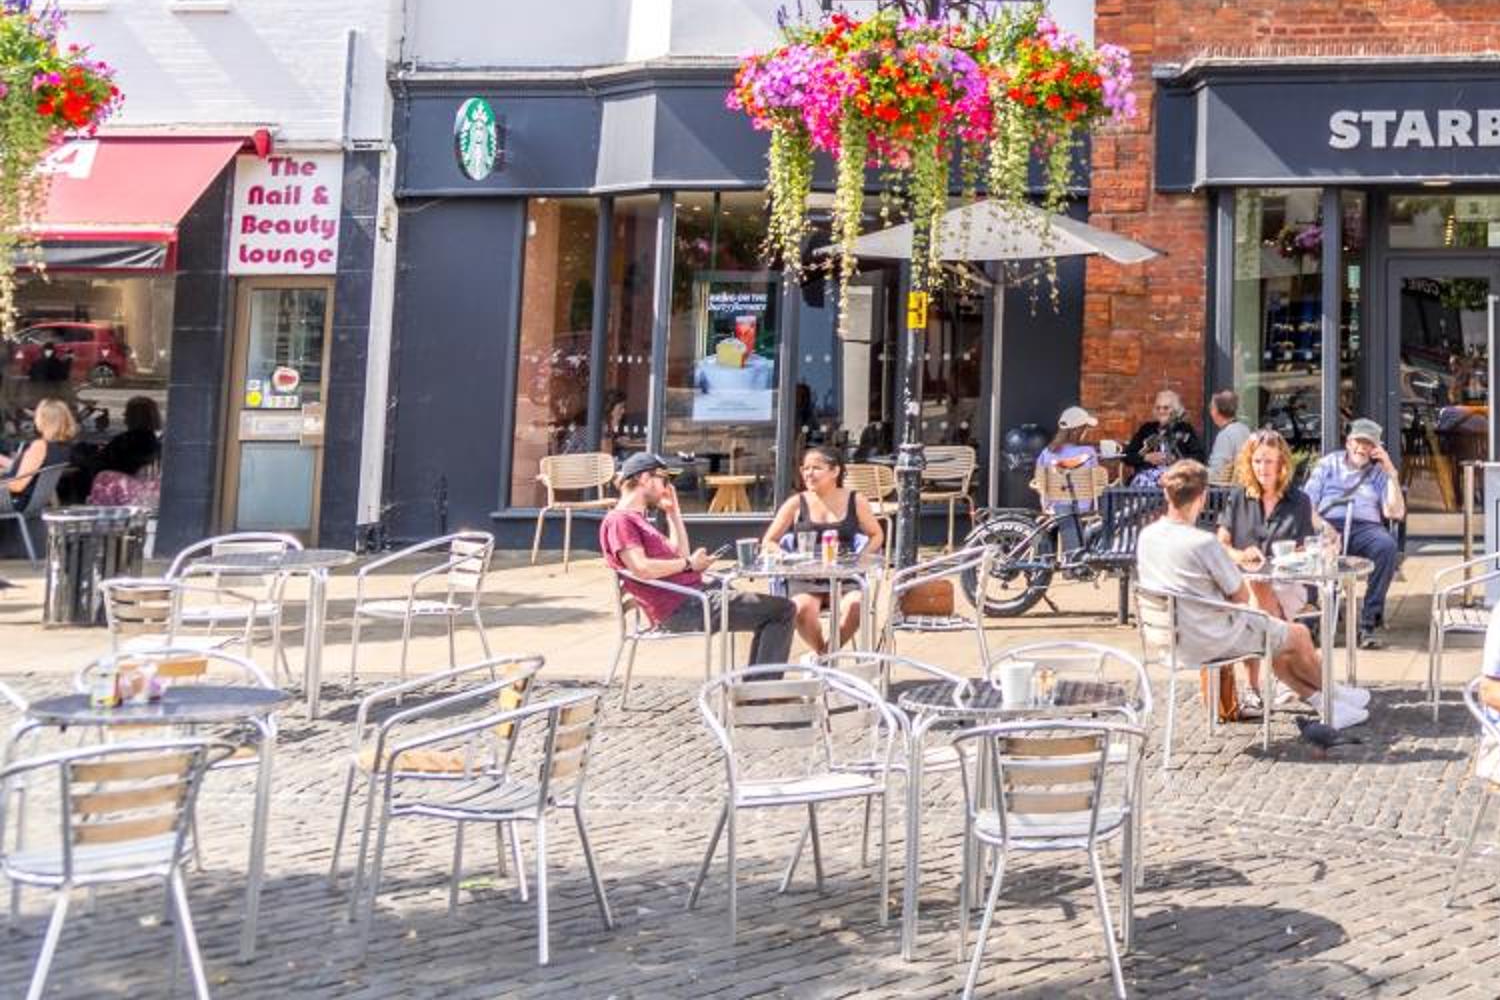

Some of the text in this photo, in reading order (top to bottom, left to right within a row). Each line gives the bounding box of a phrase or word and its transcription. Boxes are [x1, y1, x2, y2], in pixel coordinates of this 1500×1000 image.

[268, 156, 316, 176] The
[247, 185, 329, 205] Nail &
[241, 215, 336, 240] Beauty
